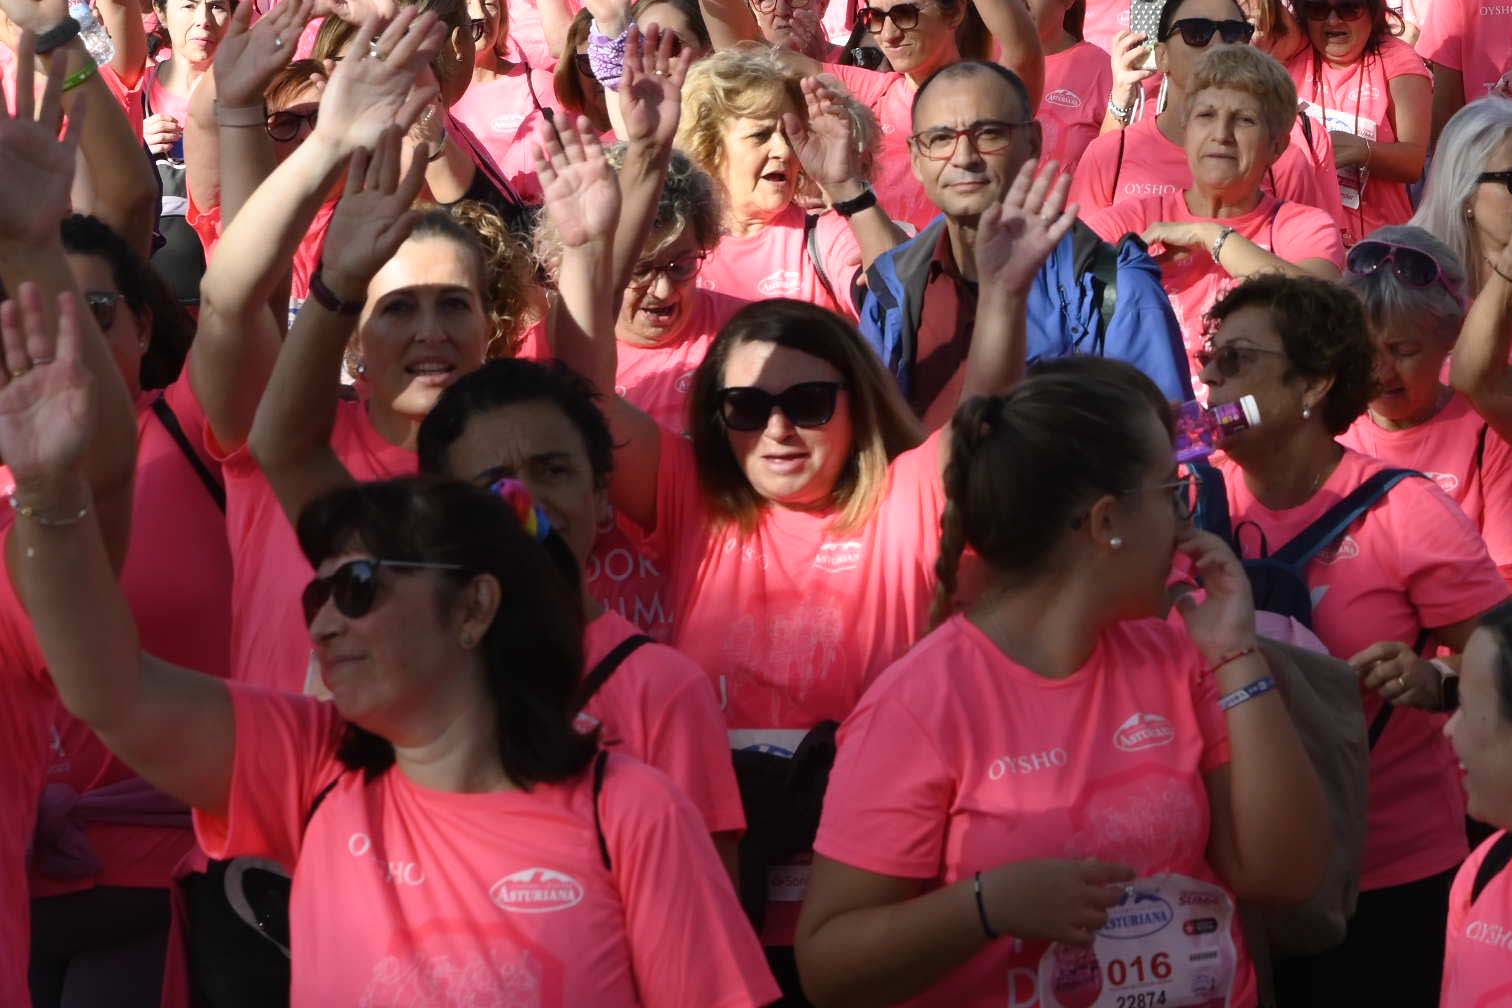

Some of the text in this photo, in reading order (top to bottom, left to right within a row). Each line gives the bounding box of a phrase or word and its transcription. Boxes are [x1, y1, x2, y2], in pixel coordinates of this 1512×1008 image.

[1124, 183, 1176, 195] OYSHO
[988, 747, 1067, 780] OYSHO
[499, 882, 576, 904] ASTURIANA
[1107, 952, 1173, 988] 016
[1115, 990, 1168, 1008] 22874
